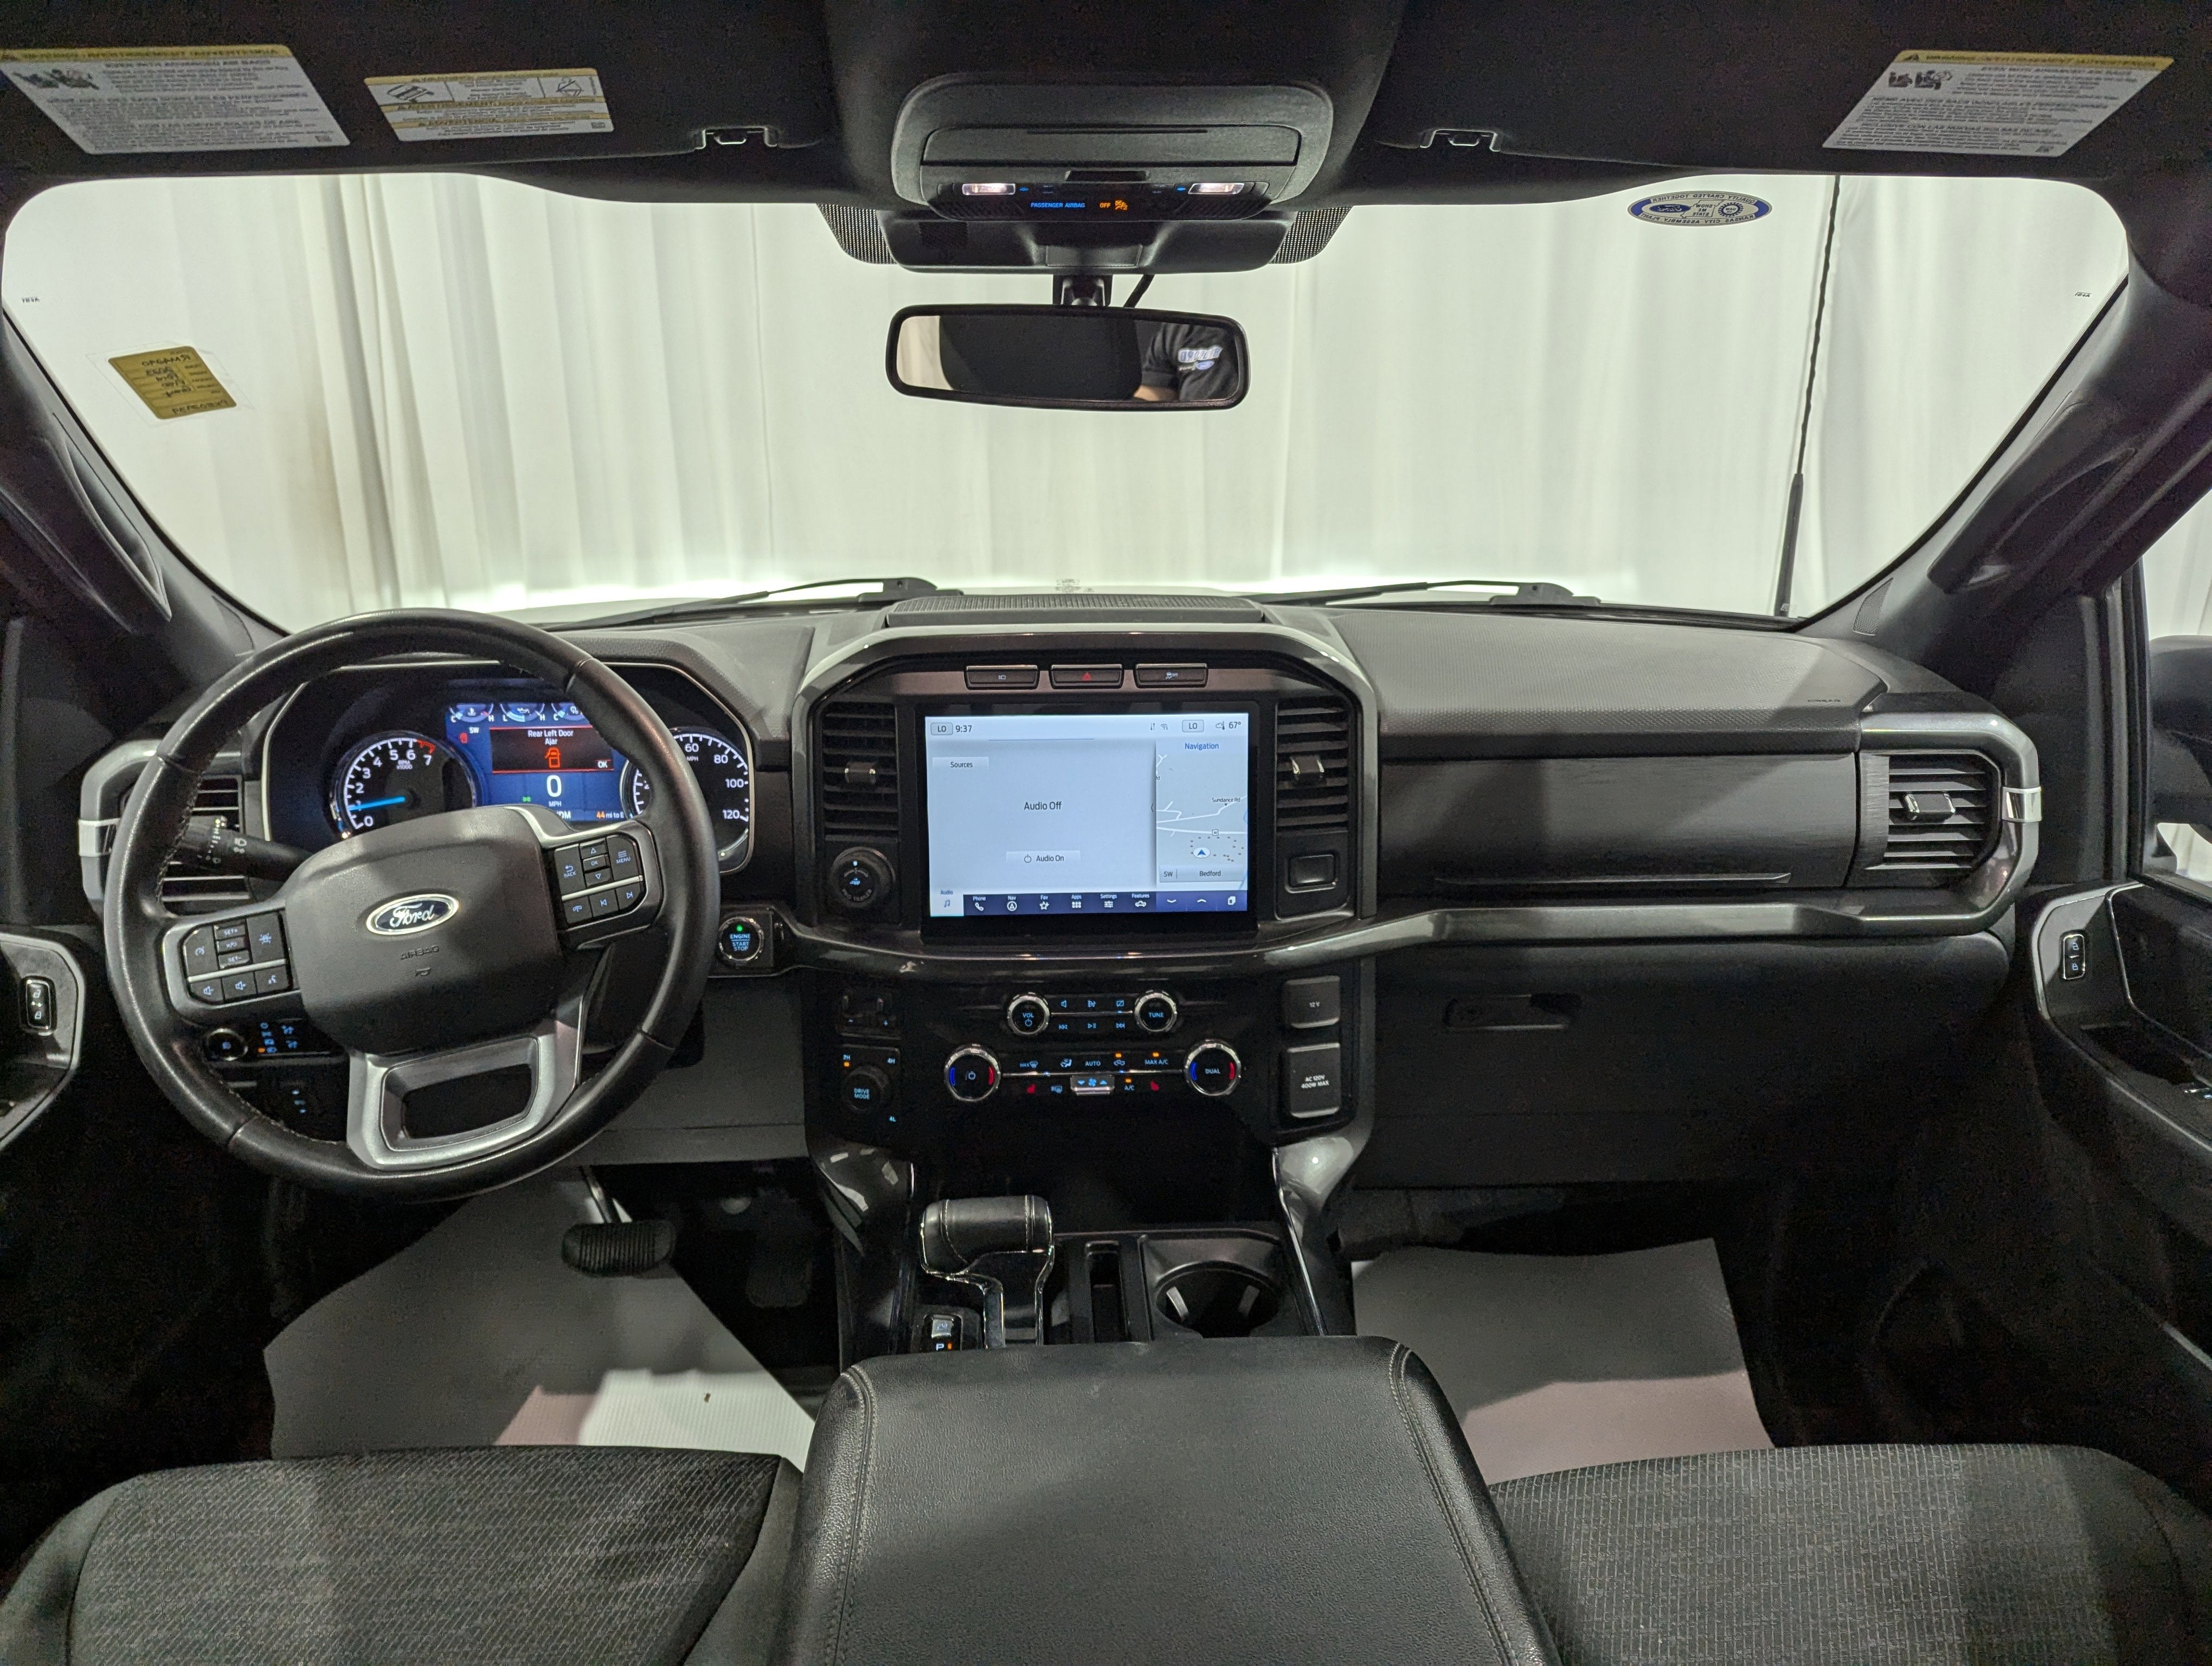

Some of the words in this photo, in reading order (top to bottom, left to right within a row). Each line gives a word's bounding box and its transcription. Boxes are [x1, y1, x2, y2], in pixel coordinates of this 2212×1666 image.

[684, 743, 699, 753] 60
[1185, 742, 1219, 751] Navigation
[389, 749, 398, 760] 5
[407, 749, 416, 760] 6
[423, 754, 432, 766] 7
[713, 754, 728, 764] 80
[372, 757, 383, 767] 4
[362, 767, 371, 779] 3
[356, 782, 364, 794] 2
[546, 774, 562, 798] 0
[725, 778, 744, 788] 100
[1024, 802, 1047, 810] Audio
[1049, 801, 1062, 810] Off
[596, 811, 606, 819] 44
[722, 809, 740, 819] 120
[364, 816, 374, 827] 0
[389, 902, 435, 928] Ford
[400, 945, 440, 960] AIRBAG
